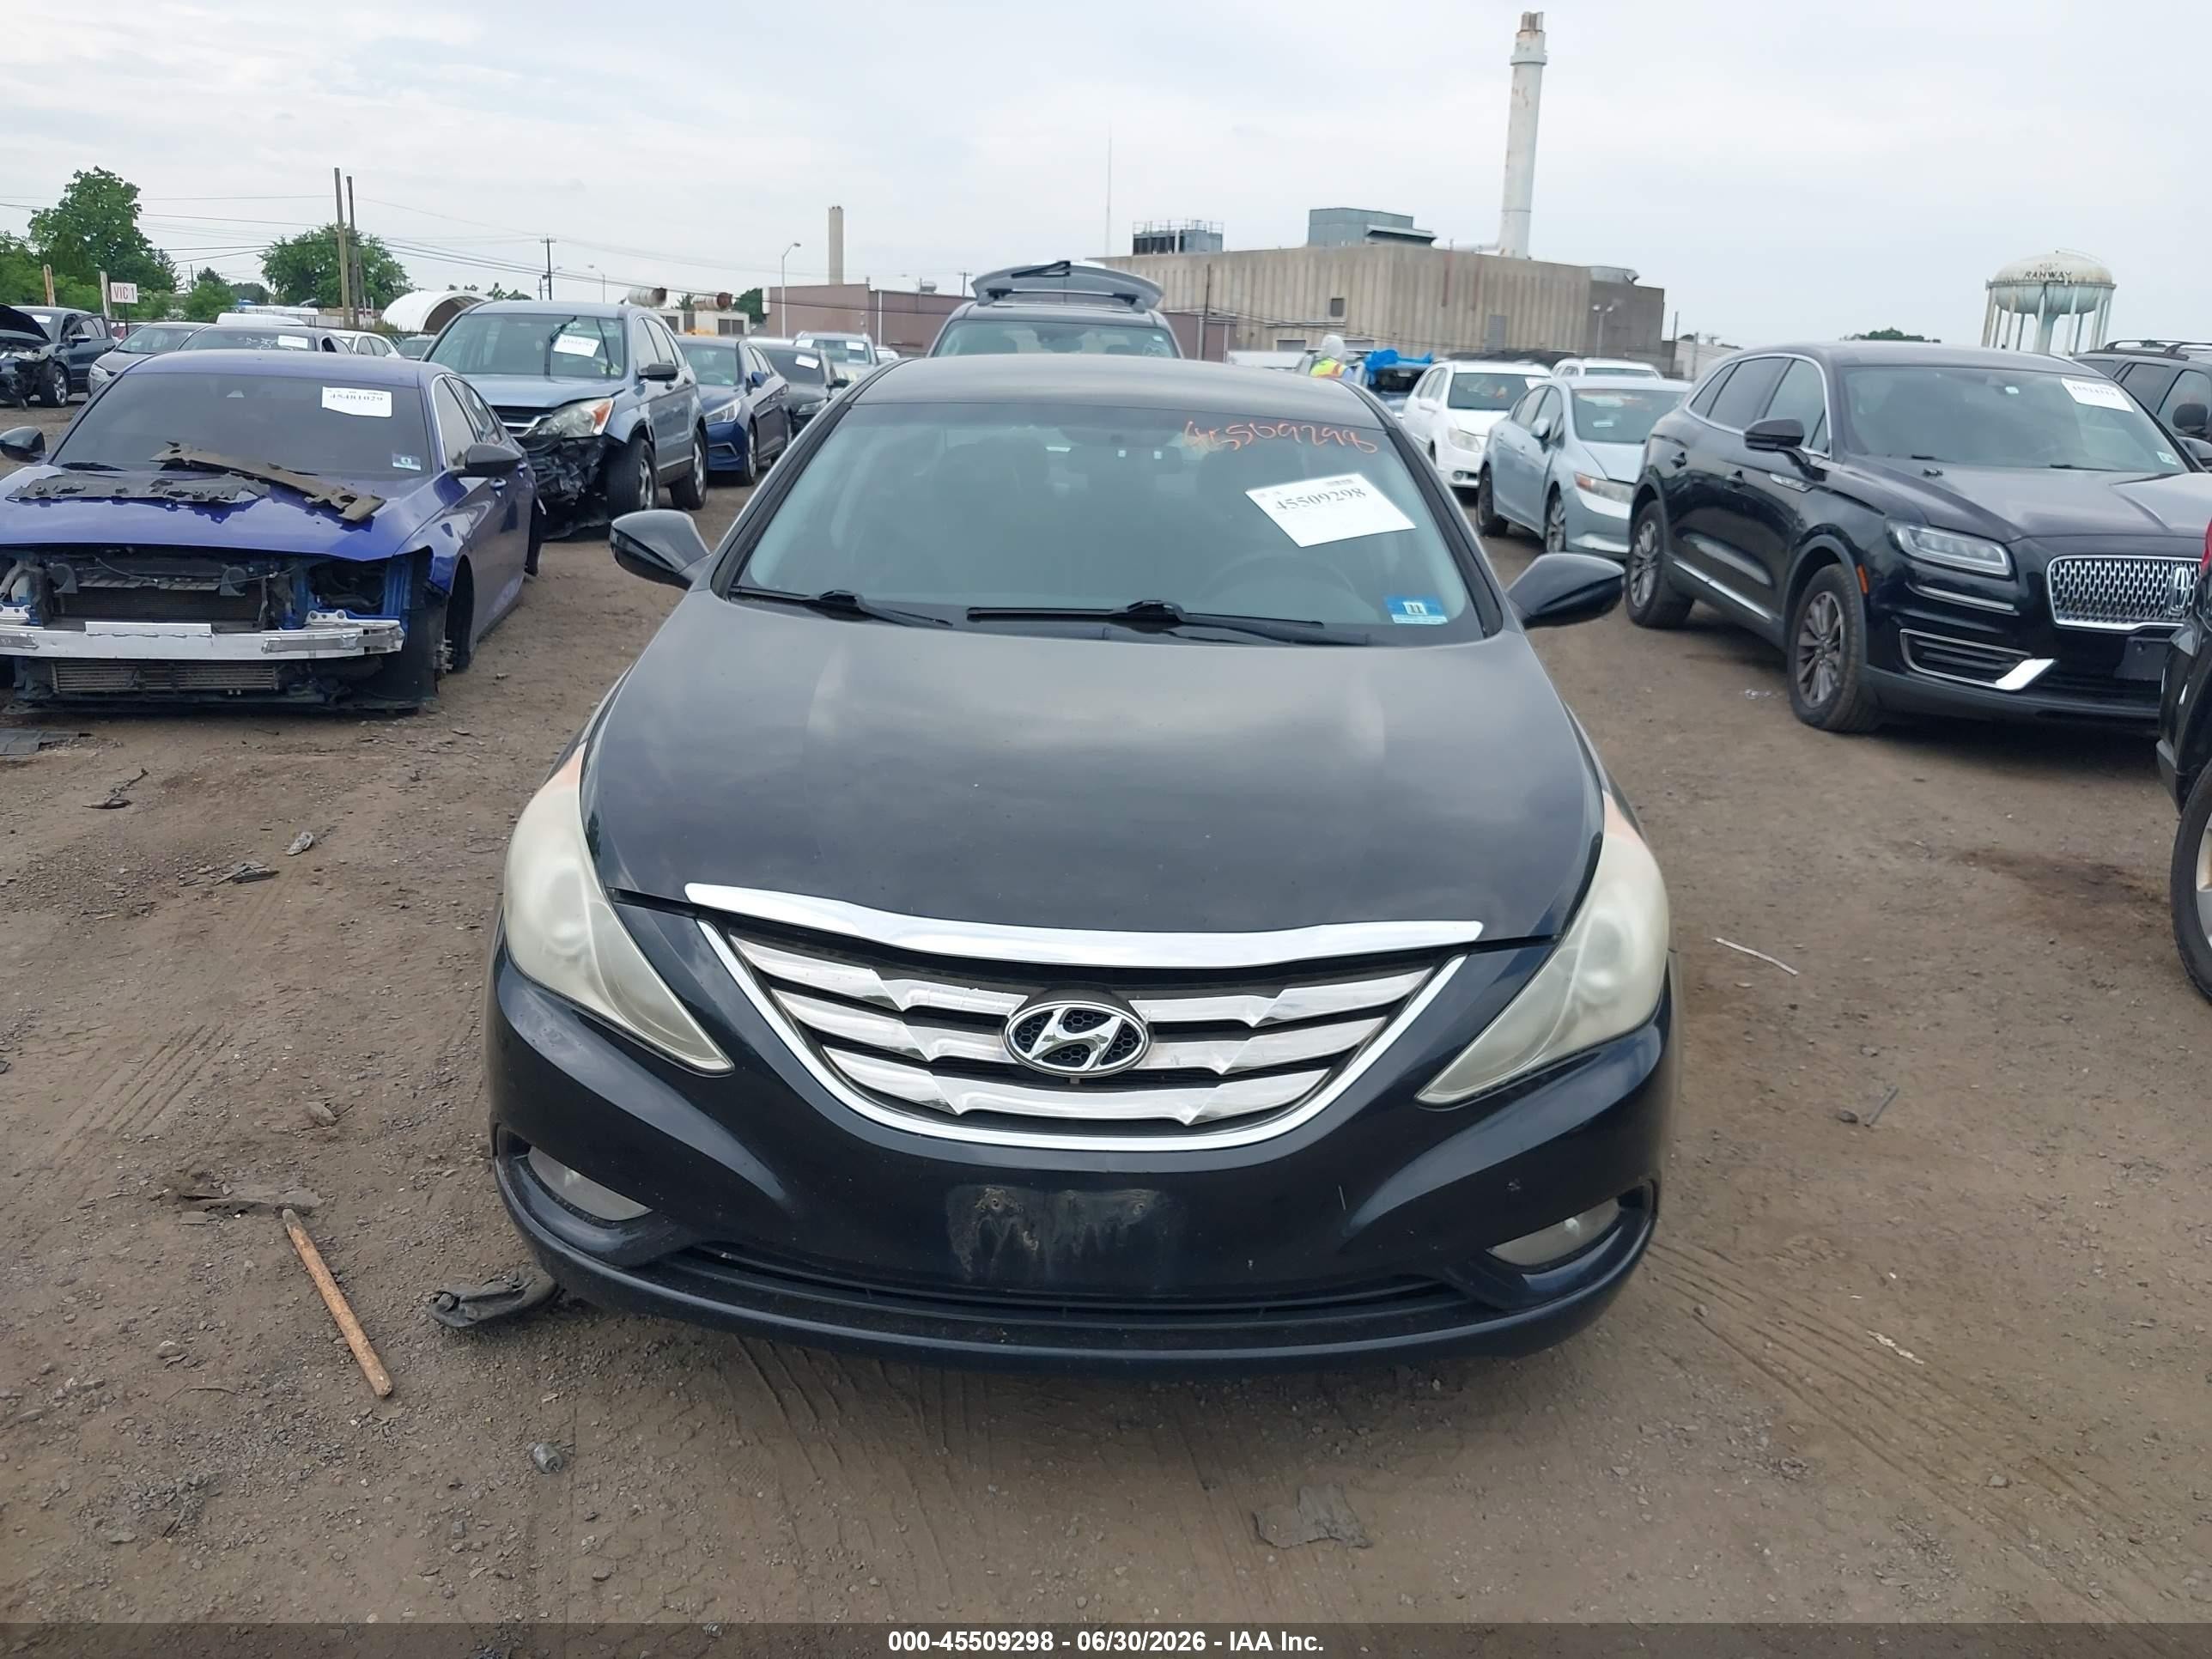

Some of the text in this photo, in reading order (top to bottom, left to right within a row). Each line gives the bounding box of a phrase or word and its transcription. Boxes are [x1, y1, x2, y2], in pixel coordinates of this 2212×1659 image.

[113, 286, 135, 301] VIC 1
[1183, 420, 1378, 454] 45509298
[1276, 487, 1368, 511] 45509298
